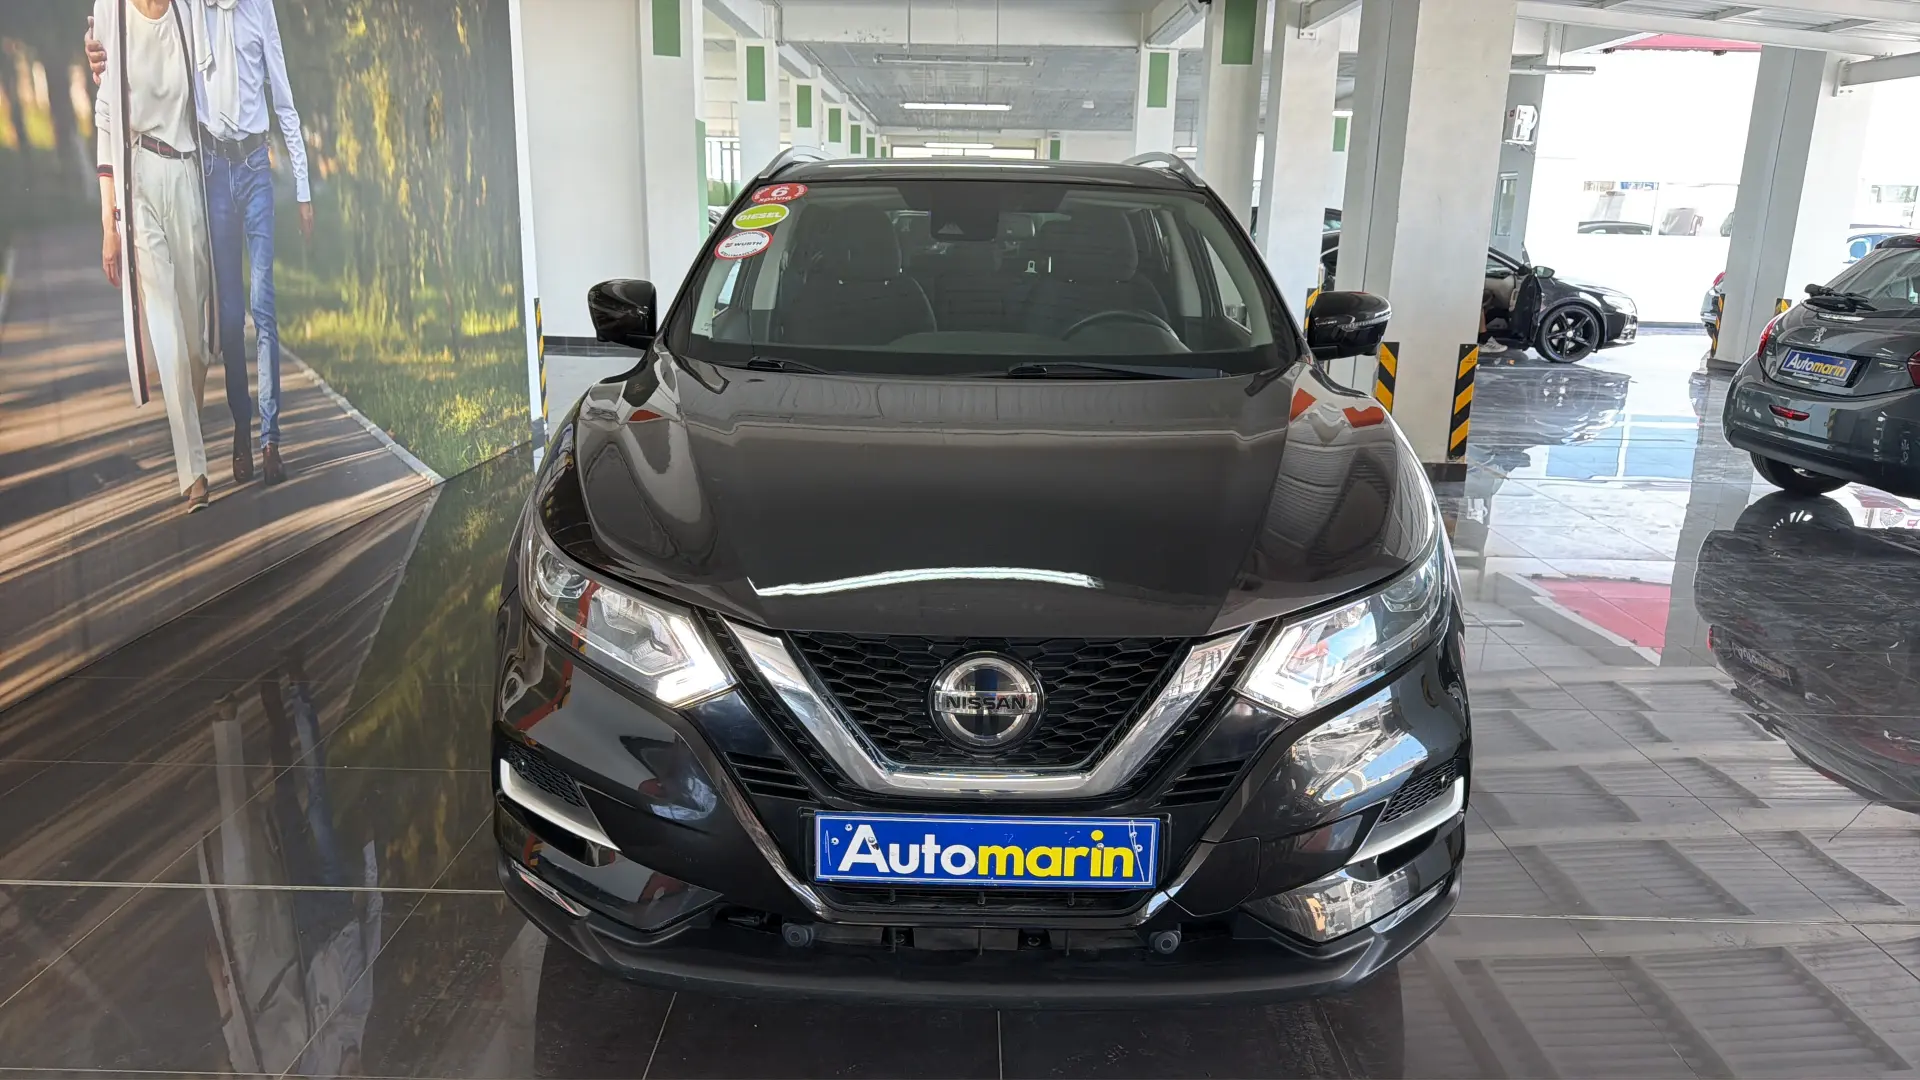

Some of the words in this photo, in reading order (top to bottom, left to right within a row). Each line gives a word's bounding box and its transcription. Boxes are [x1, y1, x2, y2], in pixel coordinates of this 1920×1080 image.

[771, 187, 790, 197] 6
[738, 211, 783, 222] DIESEL
[1786, 353, 1847, 377] Automarin
[946, 694, 1027, 710] NISSAN
[837, 823, 1135, 878] Automarin
